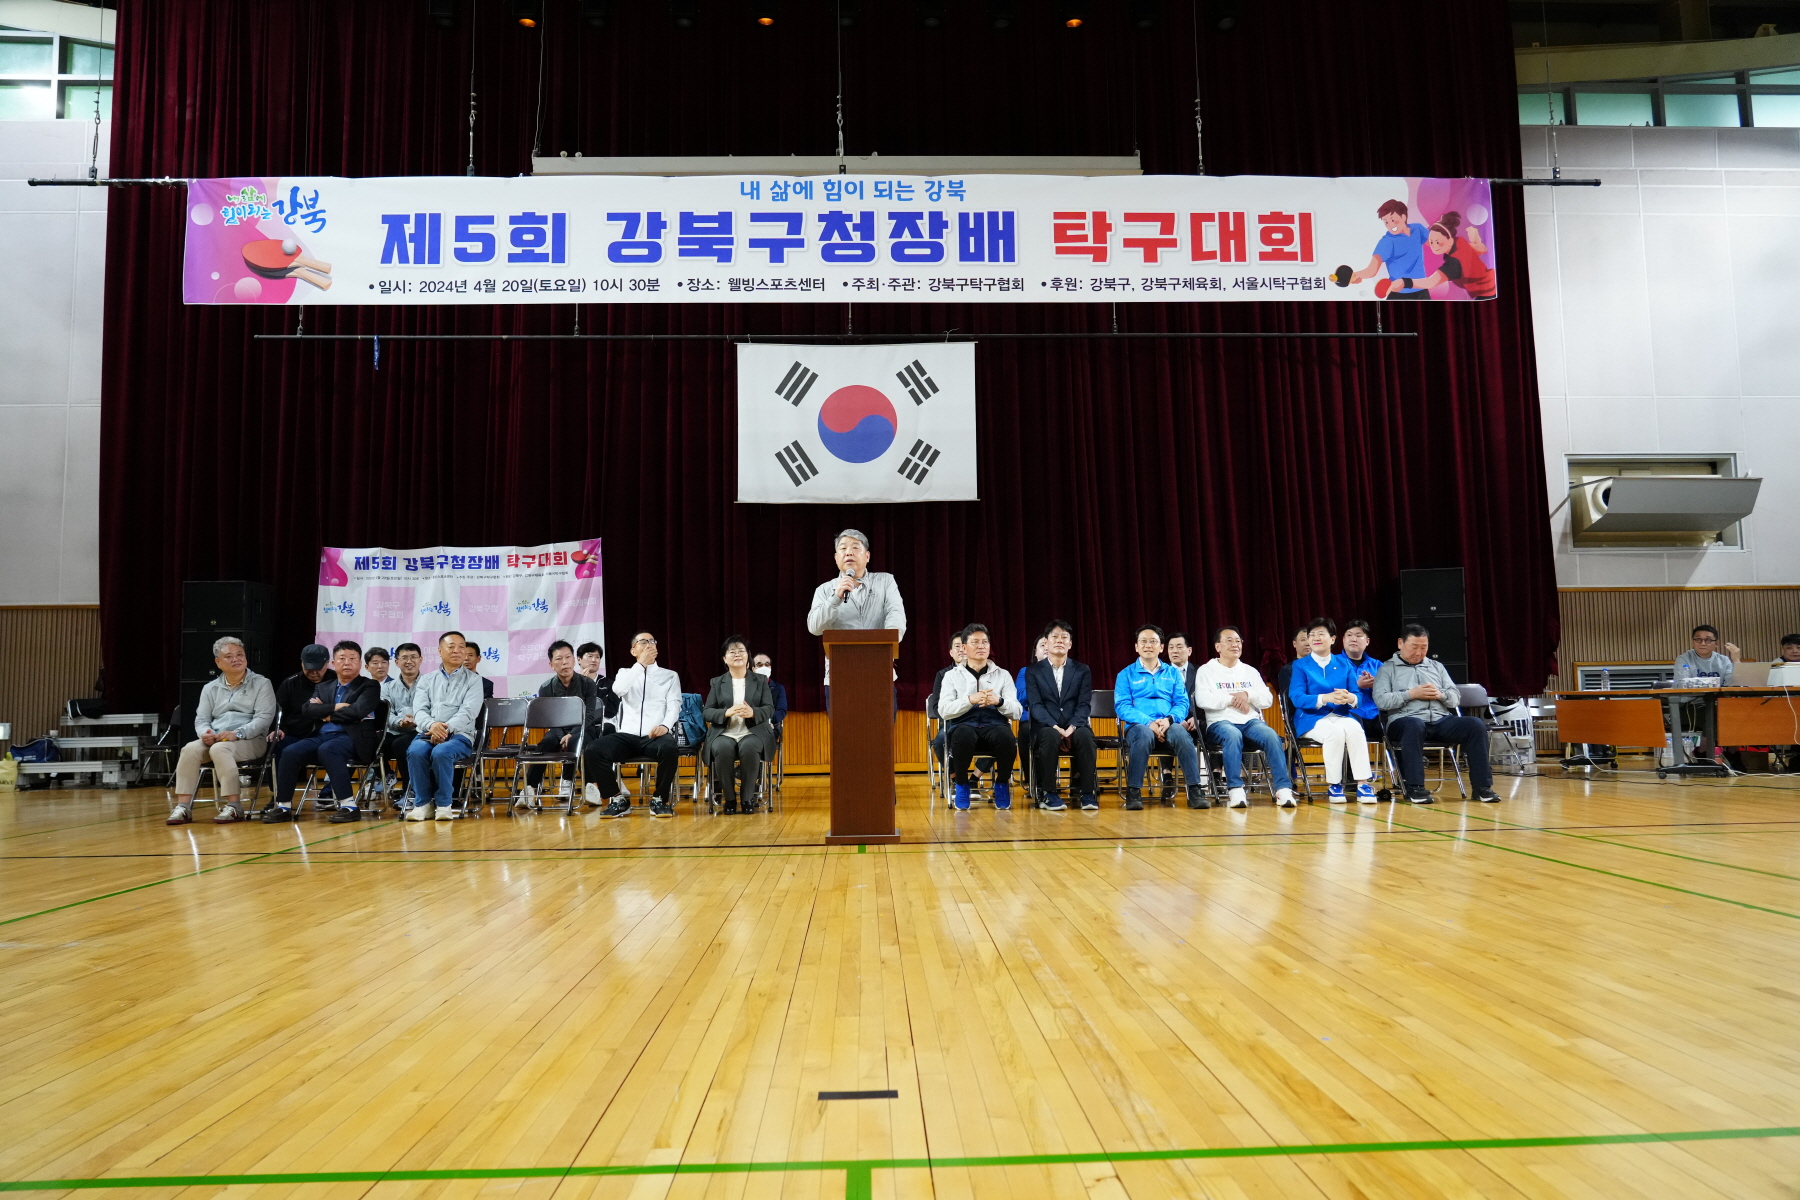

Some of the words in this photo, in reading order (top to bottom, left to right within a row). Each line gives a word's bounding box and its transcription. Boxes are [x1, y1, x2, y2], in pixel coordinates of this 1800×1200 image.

[740, 180, 760, 201] 내
[770, 180, 814, 201] 삶에
[823, 180, 864, 201] 힘이
[874, 180, 916, 201] 되는
[925, 180, 966, 202] 강북
[272, 186, 326, 233] 강북
[380, 212, 567, 265] 제5회
[606, 211, 1016, 264] 강북구청장배
[1053, 211, 1313, 264] 탁구대회
[379, 280, 412, 294] 일시:
[419, 279, 467, 294] 2024년
[474, 279, 496, 293] 4월
[502, 278, 587, 293] 20일(토요일)
[593, 279, 623, 292] 10시
[629, 278, 660, 292] 30분
[687, 278, 721, 292] 장소:
[728, 278, 825, 292] 웰빙스포츠센터
[928, 278, 1024, 292] 강북구탁구협회
[1051, 278, 1083, 291] 후원:
[1091, 278, 1135, 292] 강북구,
[1141, 277, 1227, 292] 강북구체육회,
[1233, 277, 1326, 291] 서울시탁구협회
[354, 556, 397, 571] 제5회
[403, 554, 500, 571] 강북구청장배
[507, 551, 568, 568] 탁구대회
[532, 598, 549, 613] 강북
[483, 647, 500, 662] 강북
